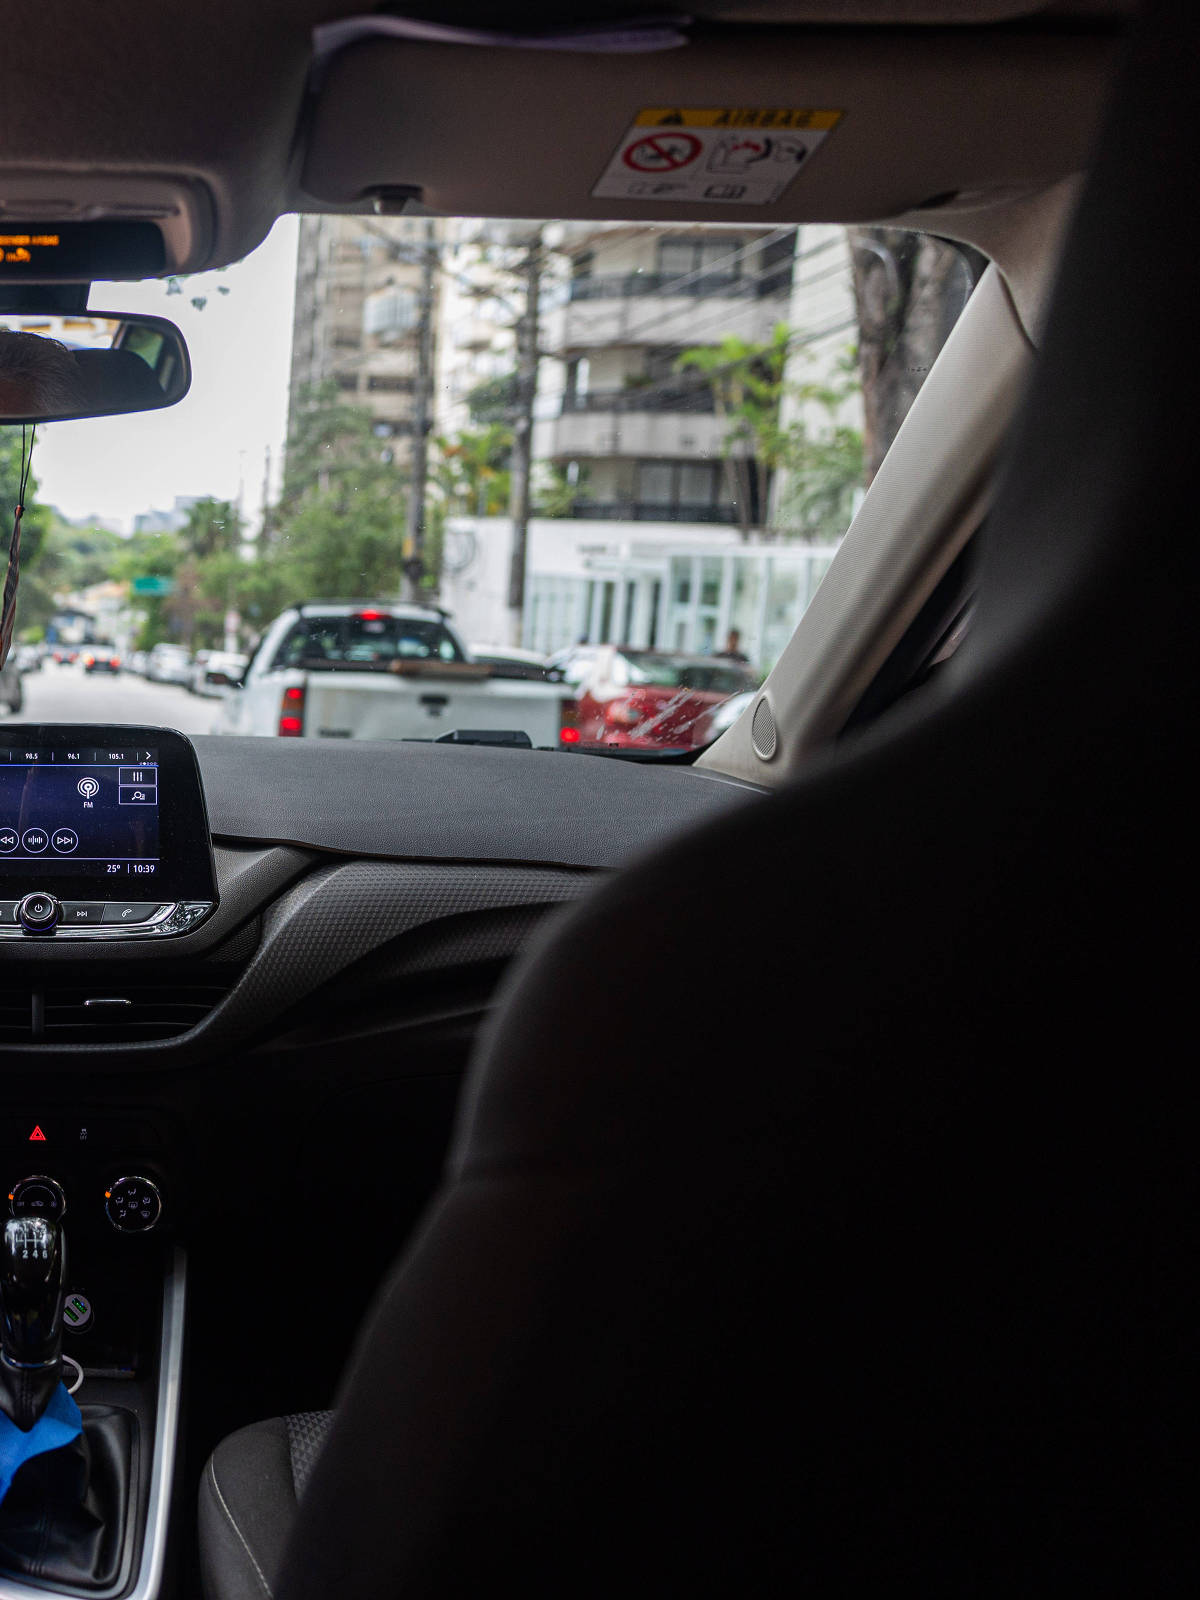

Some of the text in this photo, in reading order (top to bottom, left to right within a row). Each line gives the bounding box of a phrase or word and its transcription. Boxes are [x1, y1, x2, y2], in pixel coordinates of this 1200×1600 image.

[714, 109, 813, 127] AIRBAG
[133, 864, 155, 873] 10:39
[22, 1249, 29, 1259] 2
[32, 1249, 39, 1259] 4
